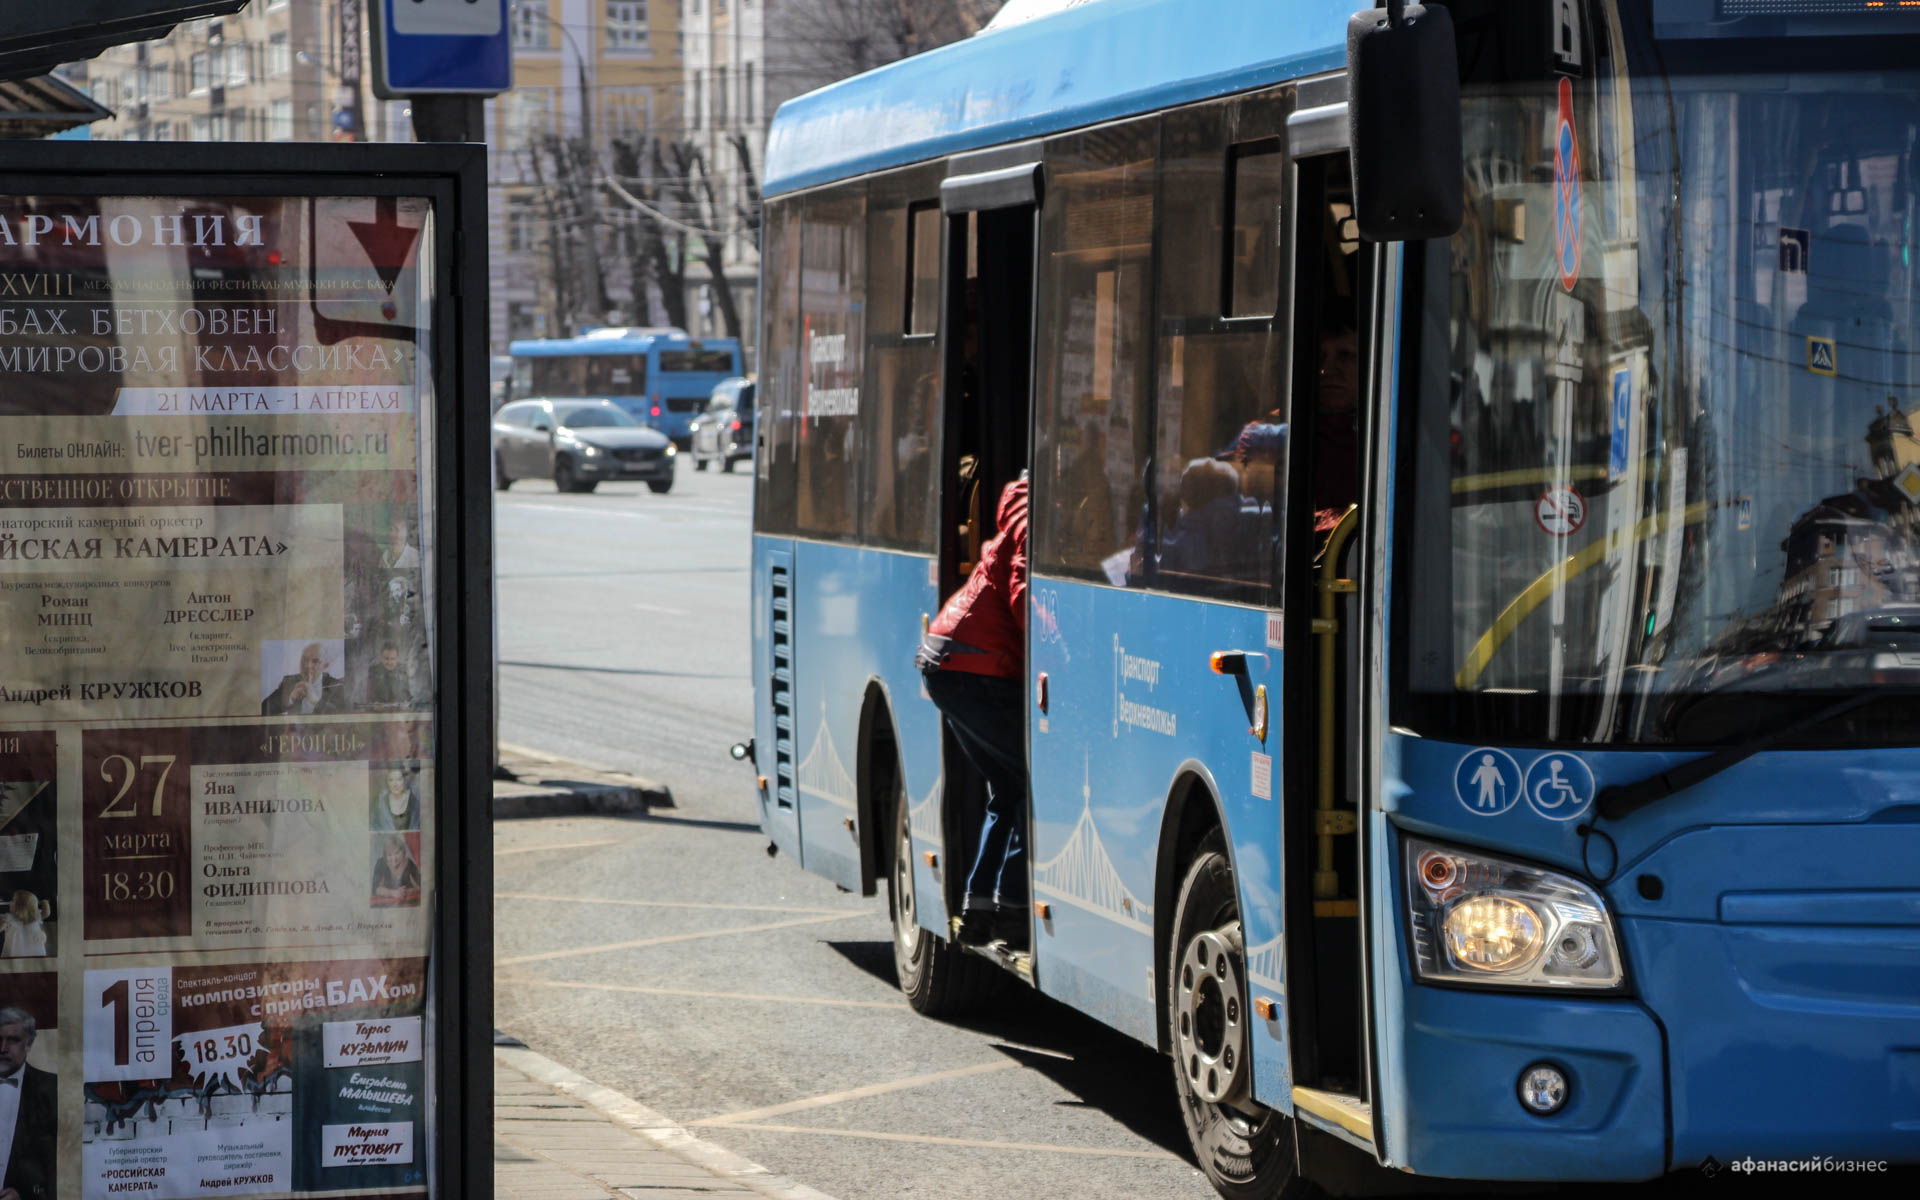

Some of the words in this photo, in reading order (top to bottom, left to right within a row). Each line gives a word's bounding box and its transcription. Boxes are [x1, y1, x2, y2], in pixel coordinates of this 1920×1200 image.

[194, 344, 404, 374] КЛАССИКА»
[158, 392, 179, 411] 21
[190, 391, 270, 411] МАРТА
[292, 391, 299, 409] 1
[309, 390, 400, 410] АПРЕЛЯ
[17, 442, 63, 459] Билеты
[67, 439, 126, 459] ОНЛАЙН:
[136, 422, 389, 467] tver-philharmonic.ru
[119, 478, 231, 499] ОТКРЫТИЕ
[78, 515, 145, 529] камерный
[150, 516, 203, 530] оркестр
[115, 535, 289, 559] КАМЕРАТА»
[41, 594, 88, 608] Роман
[187, 592, 231, 606] Антон
[37, 613, 94, 627] МИНЦ
[163, 609, 255, 626] ДРЕССЛЕР
[1119, 646, 1160, 692] Транспорт
[0, 684, 71, 706] Андрей
[79, 680, 203, 700] КРУЖКОВ
[1119, 693, 1176, 737] Верхневолжья
[98, 754, 178, 819] 27
[203, 782, 236, 796] Яна
[203, 799, 327, 815] ИВАНИЛОВА
[104, 832, 170, 854] марта
[203, 864, 251, 879] Ольга
[102, 871, 175, 901] 18.30
[203, 880, 330, 898] ФИЛИППОВА
[176, 970, 258, 990] Спектакль-концерт
[158, 977, 169, 1016] среда
[181, 977, 321, 1009] композиторы
[250, 1004, 262, 1017] с
[265, 975, 417, 1017] прибаБАХом
[101, 979, 130, 1066] 1
[135, 978, 158, 1064] апреля
[355, 1023, 392, 1039] Тарас
[193, 1032, 252, 1065] 18.30
[339, 1040, 408, 1057] КУЗЬМИН
[339, 1087, 414, 1106] МАЛЫШЕВА
[347, 1126, 389, 1143] Мария
[333, 1142, 403, 1157] ПУСТОВИТ
[101, 1167, 166, 1179] «РОССИЙСКАЯ
[199, 1177, 232, 1189] Андрей
[233, 1174, 274, 1186] КРУЖКОВ
[108, 1181, 158, 1193] КАМЕРАТА»
